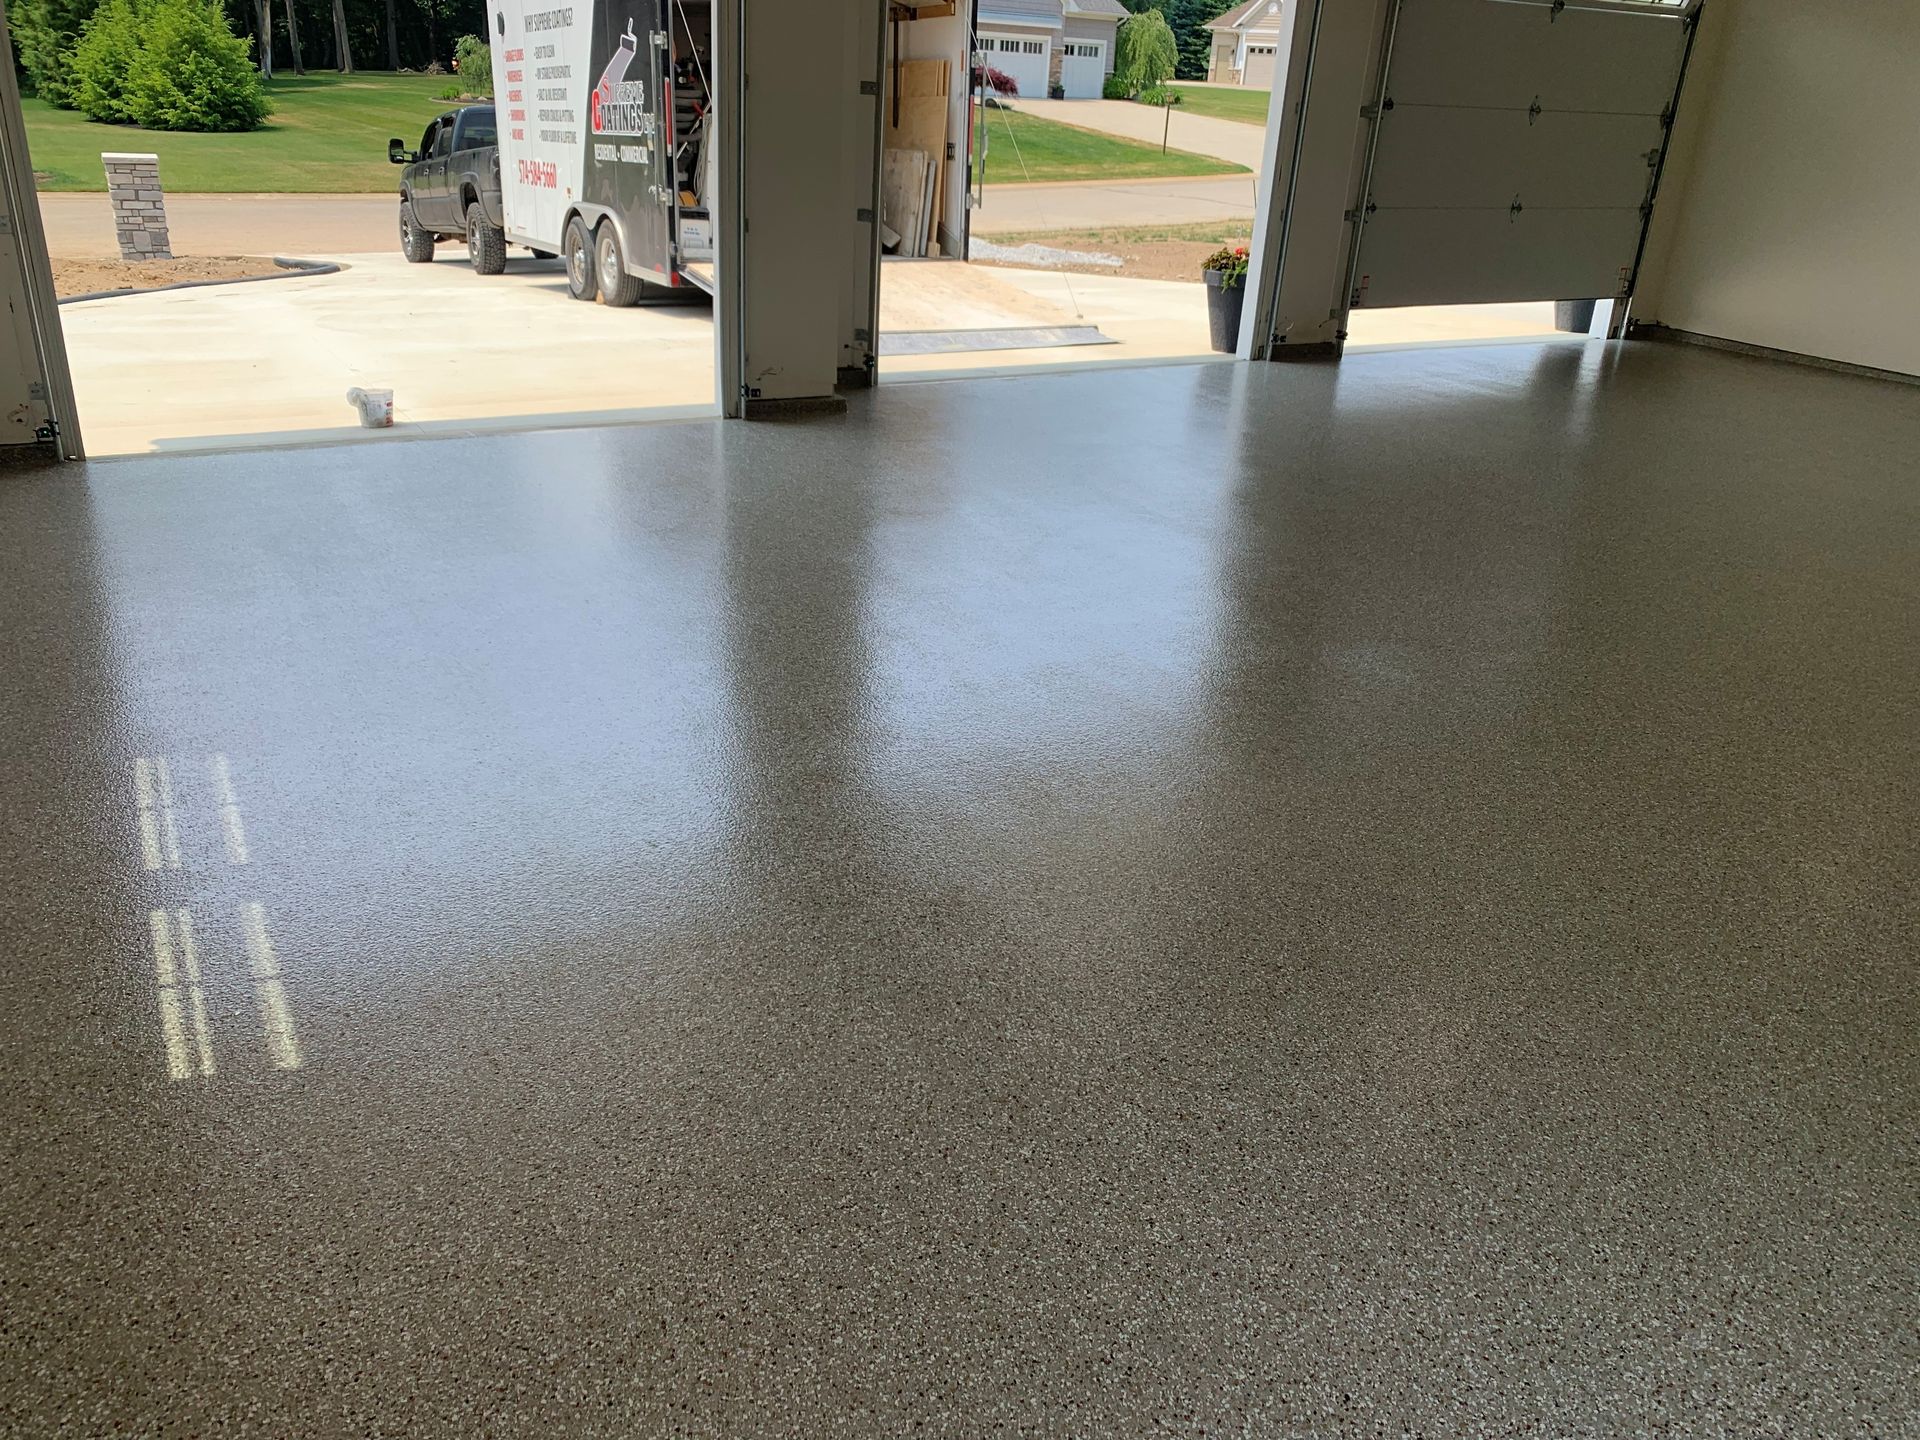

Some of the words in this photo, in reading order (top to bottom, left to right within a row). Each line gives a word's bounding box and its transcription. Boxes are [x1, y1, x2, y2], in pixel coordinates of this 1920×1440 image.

[534, 11, 551, 32] SUPREME
[602, 77, 644, 104] SUPREME
[592, 89, 643, 136] COATINGS
[594, 144, 618, 162] RESIDENTIAL
[620, 145, 648, 164] COMMERCIAL
[518, 159, 557, 189] 574-584-5660
